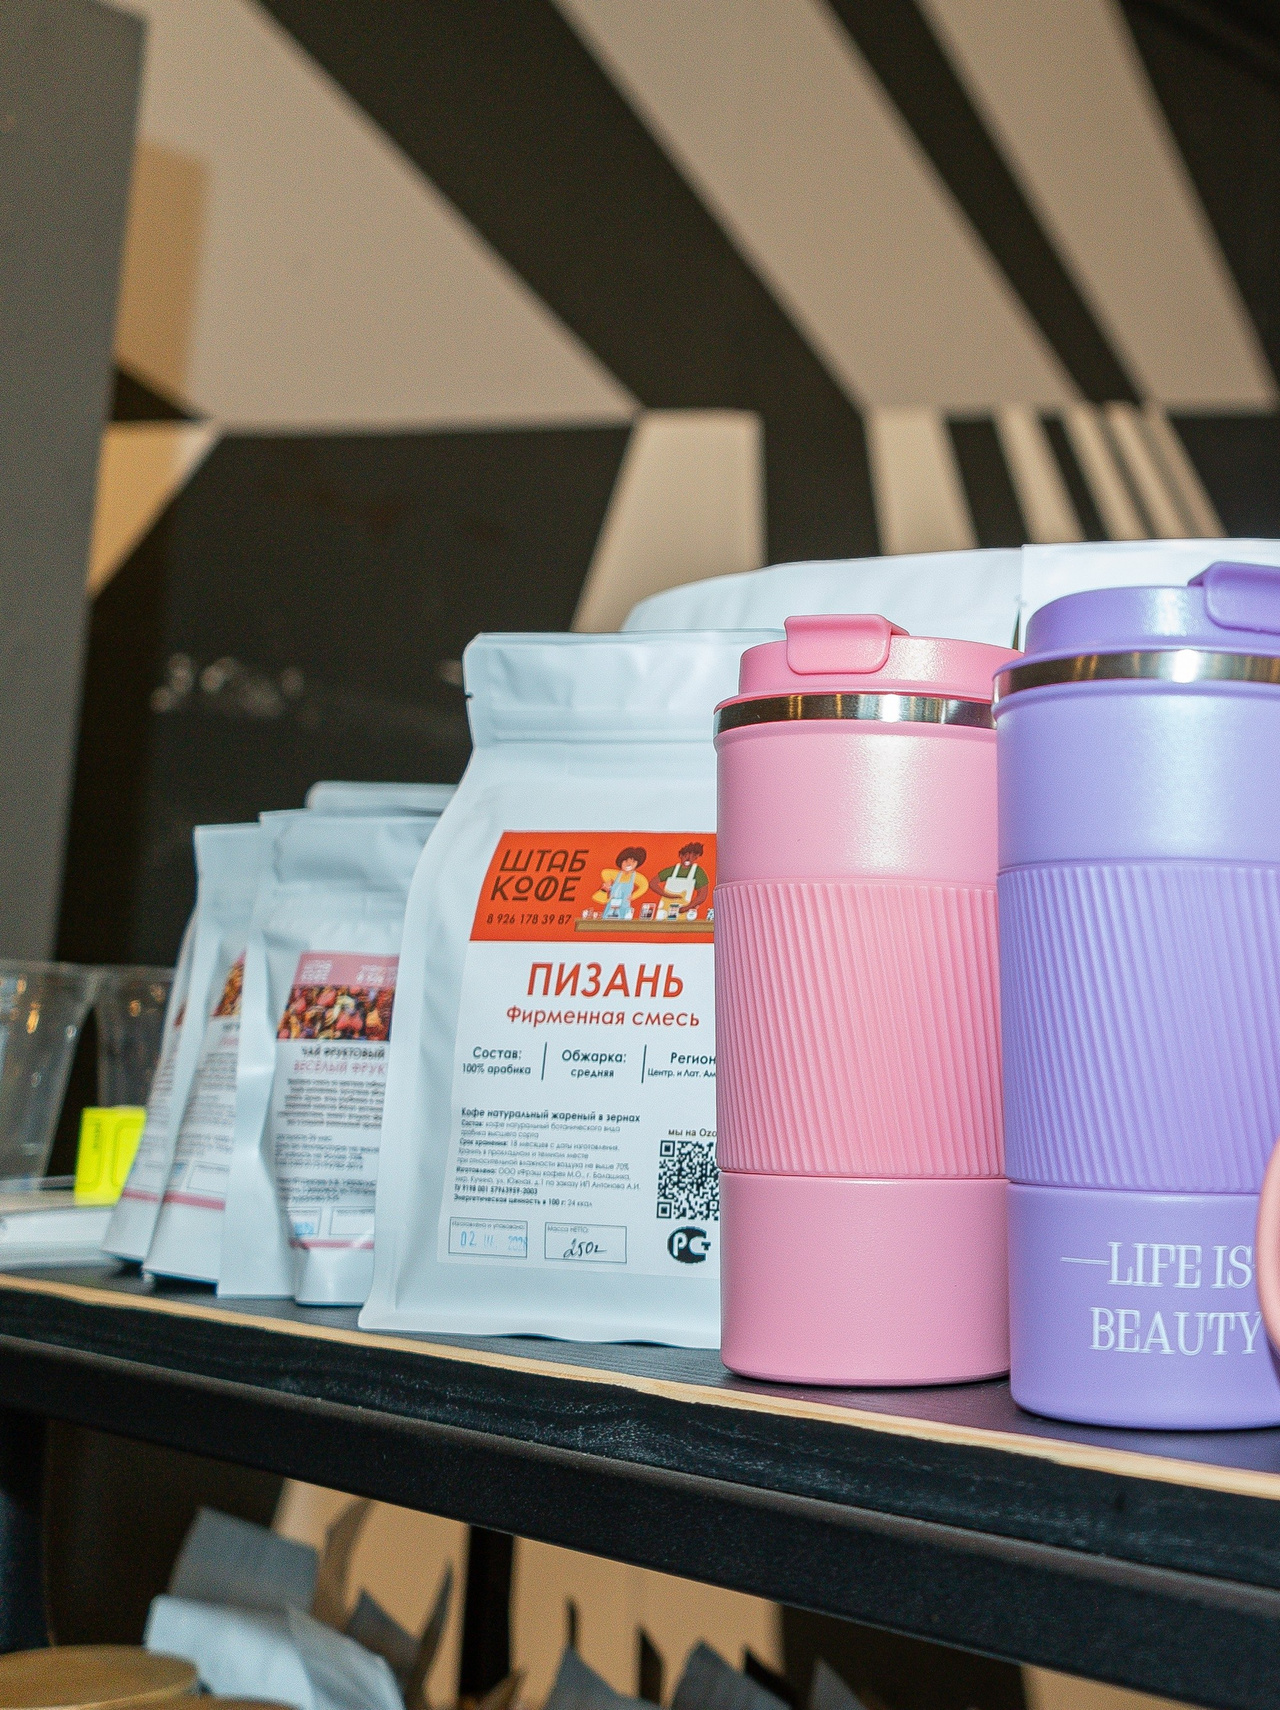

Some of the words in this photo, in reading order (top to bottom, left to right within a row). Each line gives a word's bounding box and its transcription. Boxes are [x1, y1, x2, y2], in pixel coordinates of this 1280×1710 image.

[499, 848, 590, 873] ШТАБ
[490, 875, 582, 903] КОФЕ
[486, 913, 494, 925] 8
[497, 913, 516, 926] 926
[520, 913, 540, 926] 178
[541, 914, 556, 926] 39
[557, 914, 573, 926] 87
[527, 961, 684, 999] ПИЗАНЬ
[506, 1004, 626, 1028] Фирменная
[632, 1011, 700, 1027] смесь
[472, 1046, 522, 1060] Состав:
[561, 1049, 627, 1065] Обжарка:
[462, 1062, 484, 1074] 100%
[487, 1064, 532, 1075] арабика
[570, 1069, 614, 1079] средняя
[647, 1068, 675, 1078] Центр.
[704, 1070, 716, 1078] Ам
[461, 1107, 485, 1118] Кофе
[487, 1109, 549, 1119] натуральный
[551, 1110, 596, 1121] жареный
[598, 1113, 603, 1121] в
[606, 1113, 641, 1123] зернах
[668, 1129, 683, 1137] мы
[685, 1129, 697, 1137] на
[699, 1128, 717, 1137] Ozo
[1107, 1241, 1203, 1289] LIFE
[1211, 1244, 1254, 1290] IS
[1089, 1306, 1264, 1356] BEAUTY
